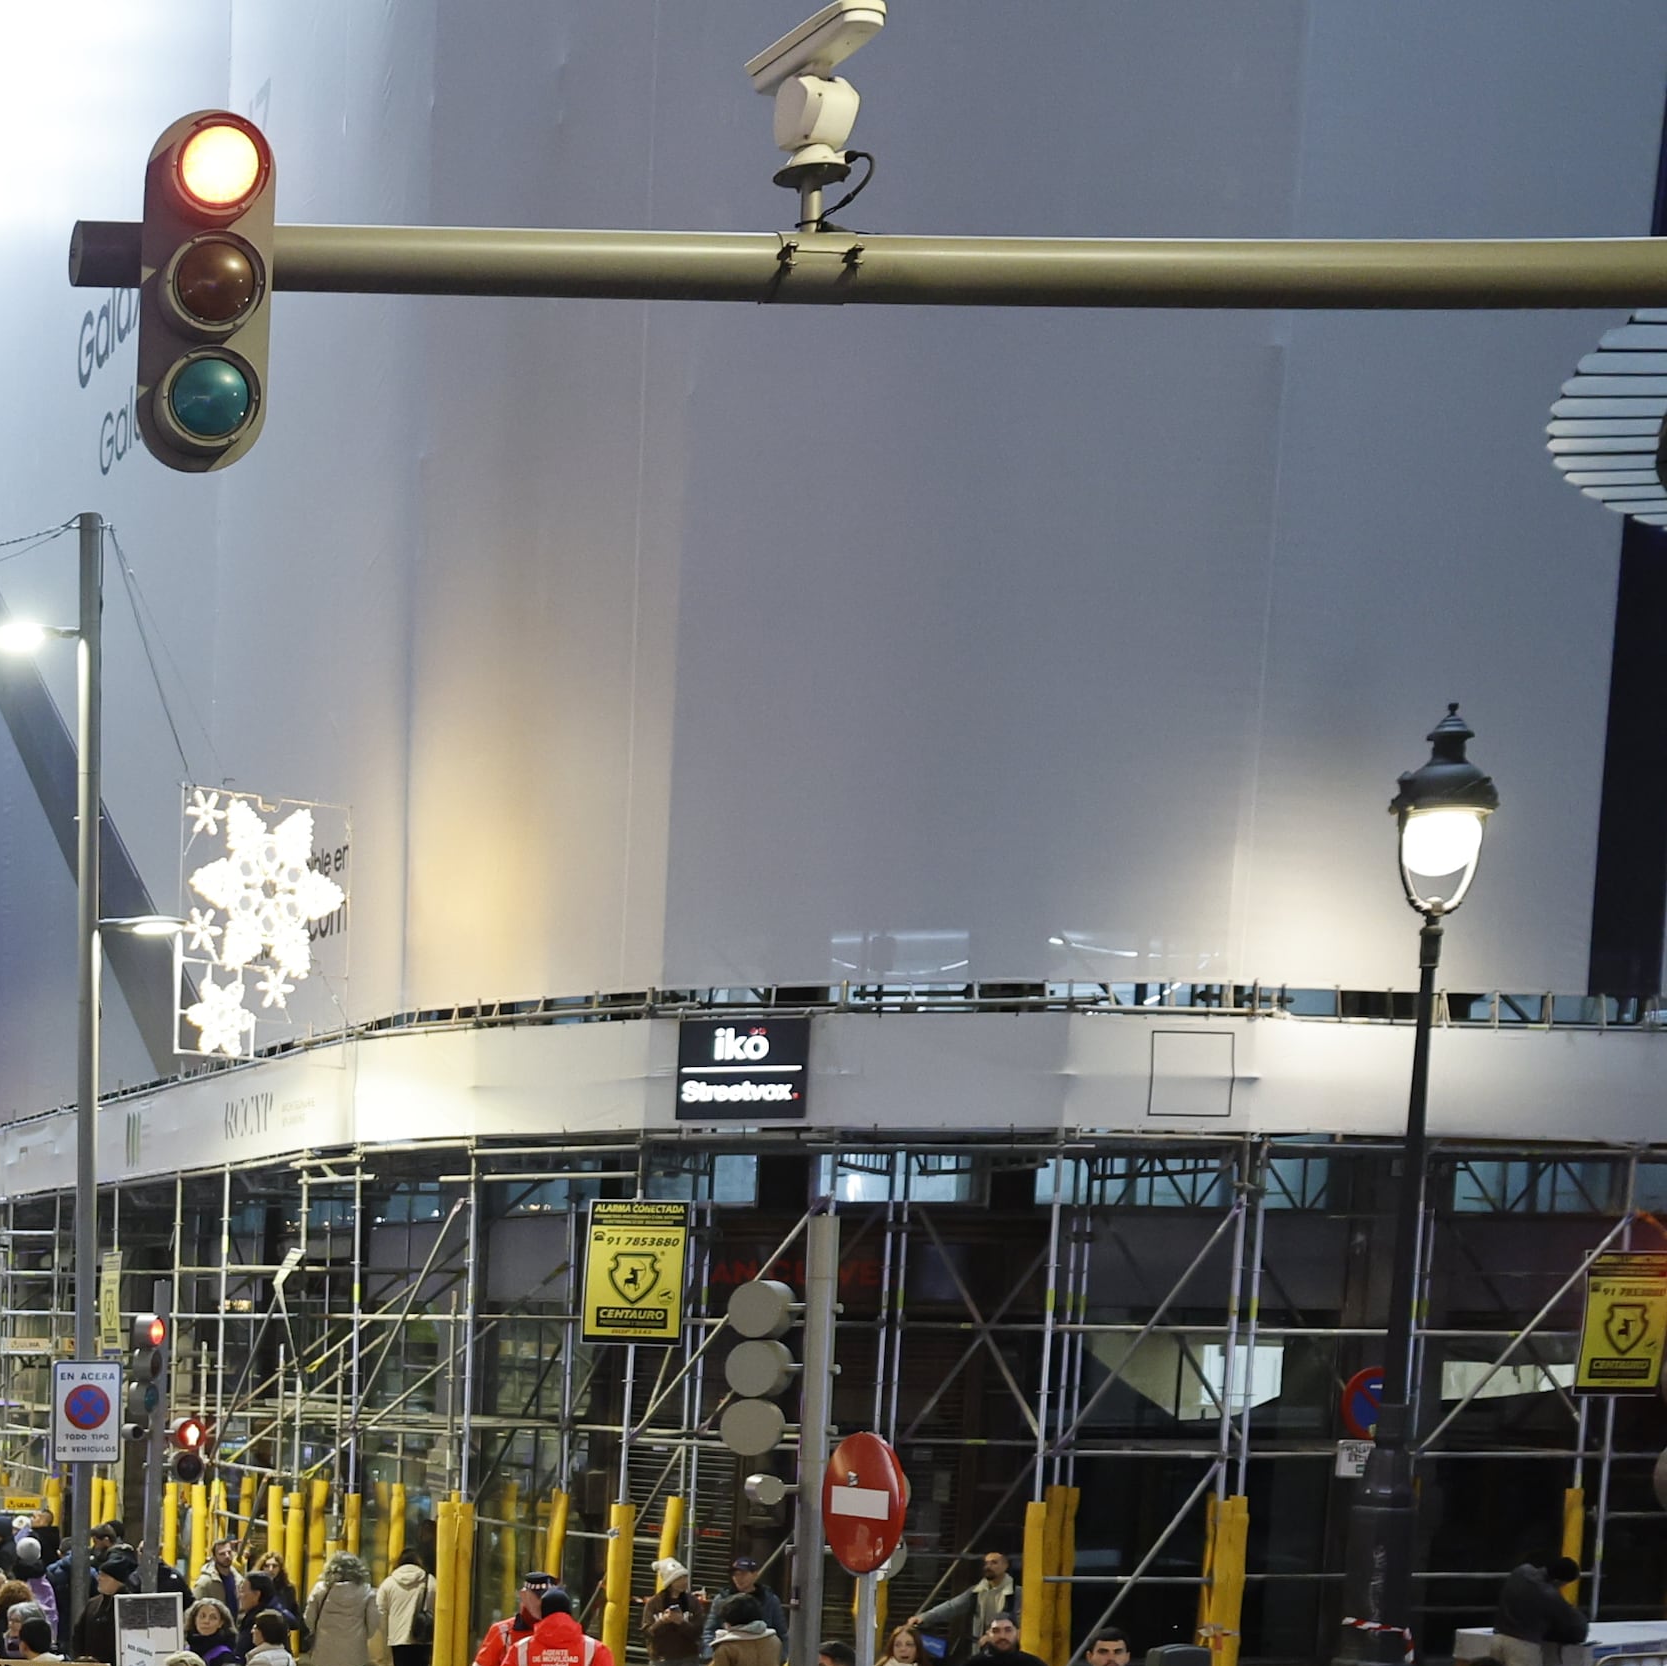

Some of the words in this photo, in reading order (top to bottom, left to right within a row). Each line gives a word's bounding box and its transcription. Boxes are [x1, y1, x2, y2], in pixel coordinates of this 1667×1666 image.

[595, 1204, 631, 1214] ALARMA
[632, 1203, 685, 1214] CONECTADA
[607, 1236, 620, 1246] 91
[599, 1308, 665, 1320] CENTAURO
[60, 1372, 75, 1381] EN
[80, 1372, 116, 1381] ACERA
[65, 1433, 87, 1441] TODO
[91, 1433, 110, 1441] TIPO
